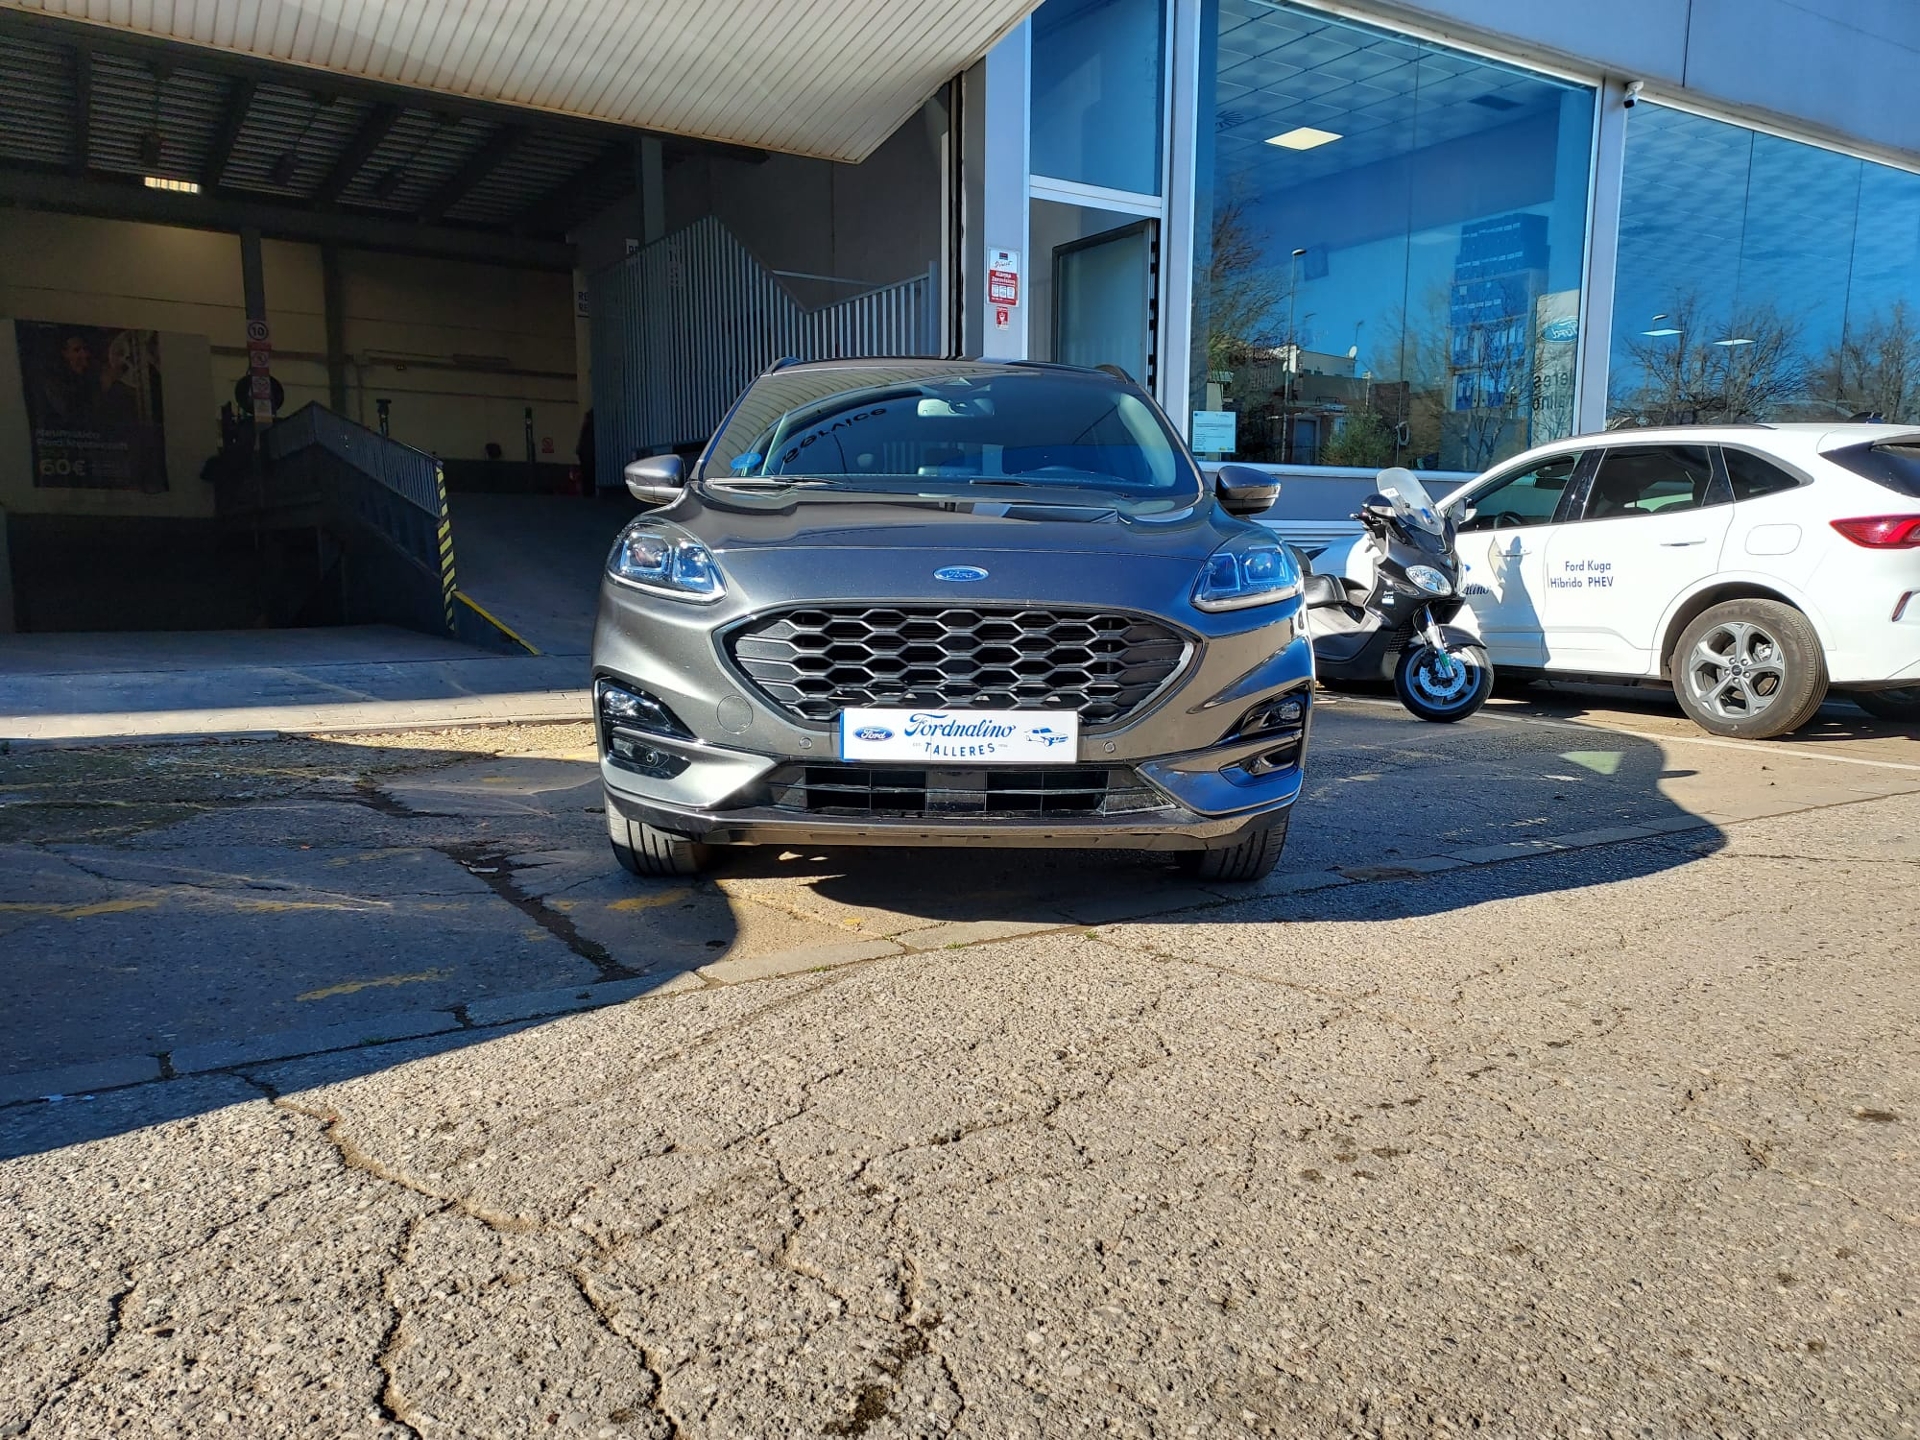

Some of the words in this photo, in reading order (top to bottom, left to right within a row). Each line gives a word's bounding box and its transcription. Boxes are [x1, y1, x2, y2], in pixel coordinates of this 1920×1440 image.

[252, 325, 265, 337] 10
[39, 458, 86, 476] 60€
[1565, 560, 1585, 572] Ford
[1587, 560, 1612, 574] Kuga
[1588, 576, 1614, 588] PHEV
[904, 713, 1017, 738] Fordnalino
[925, 742, 995, 757] TALLERES
